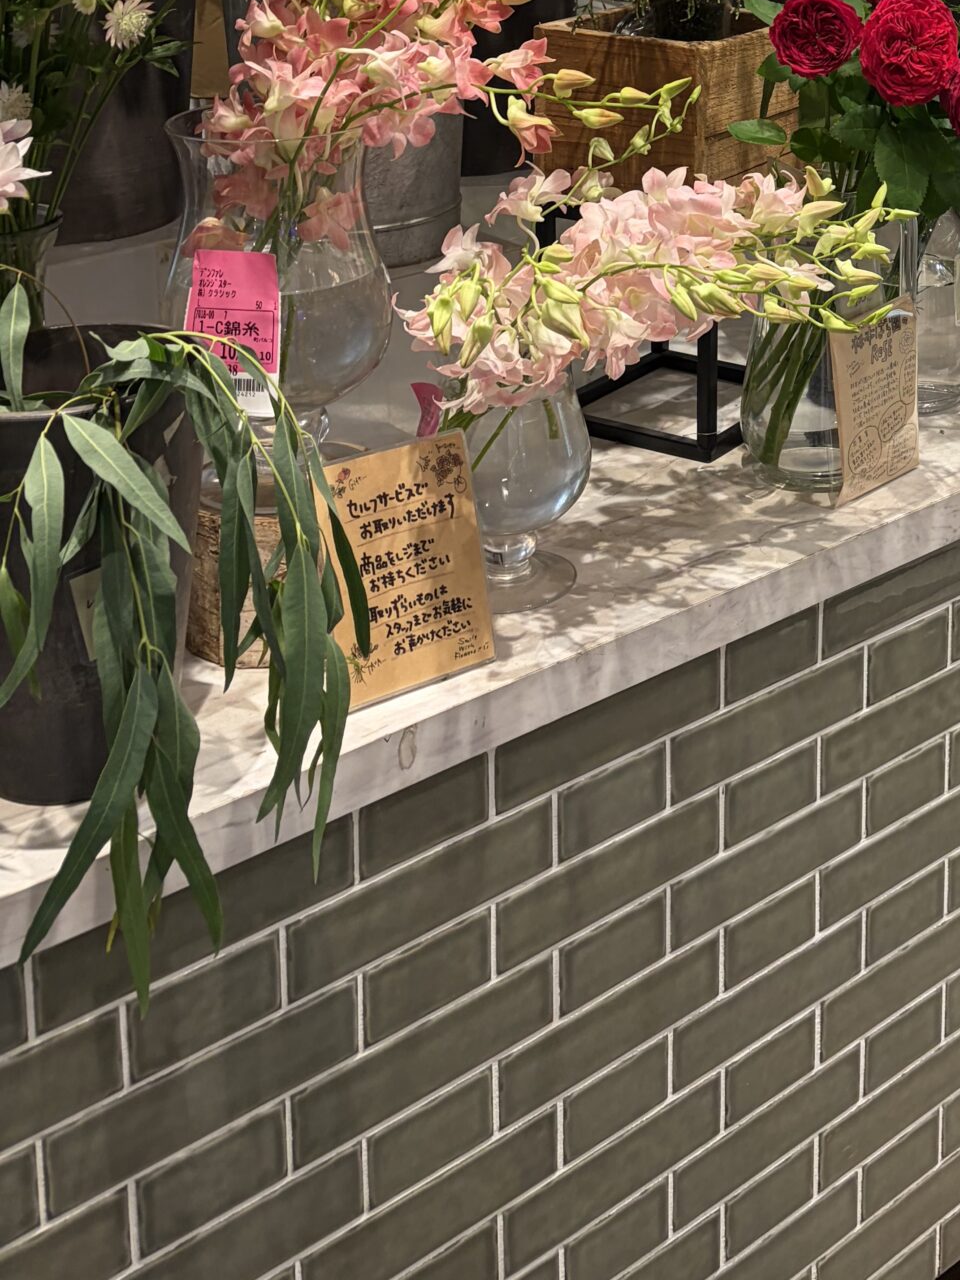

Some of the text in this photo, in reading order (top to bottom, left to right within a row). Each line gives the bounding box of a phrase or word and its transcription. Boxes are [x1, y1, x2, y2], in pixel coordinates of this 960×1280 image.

[260, 352, 271, 361] 10
[347, 482, 429, 519] セルフサービスで
[360, 493, 456, 540] お取りいただけます
[360, 539, 435, 577] 商品をレジまで
[370, 554, 451, 593] お持ちください
[368, 584, 449, 624] 取りずらいものは
[385, 596, 473, 638] スタッフまでお気軽に
[393, 619, 472, 656] お声かけください
